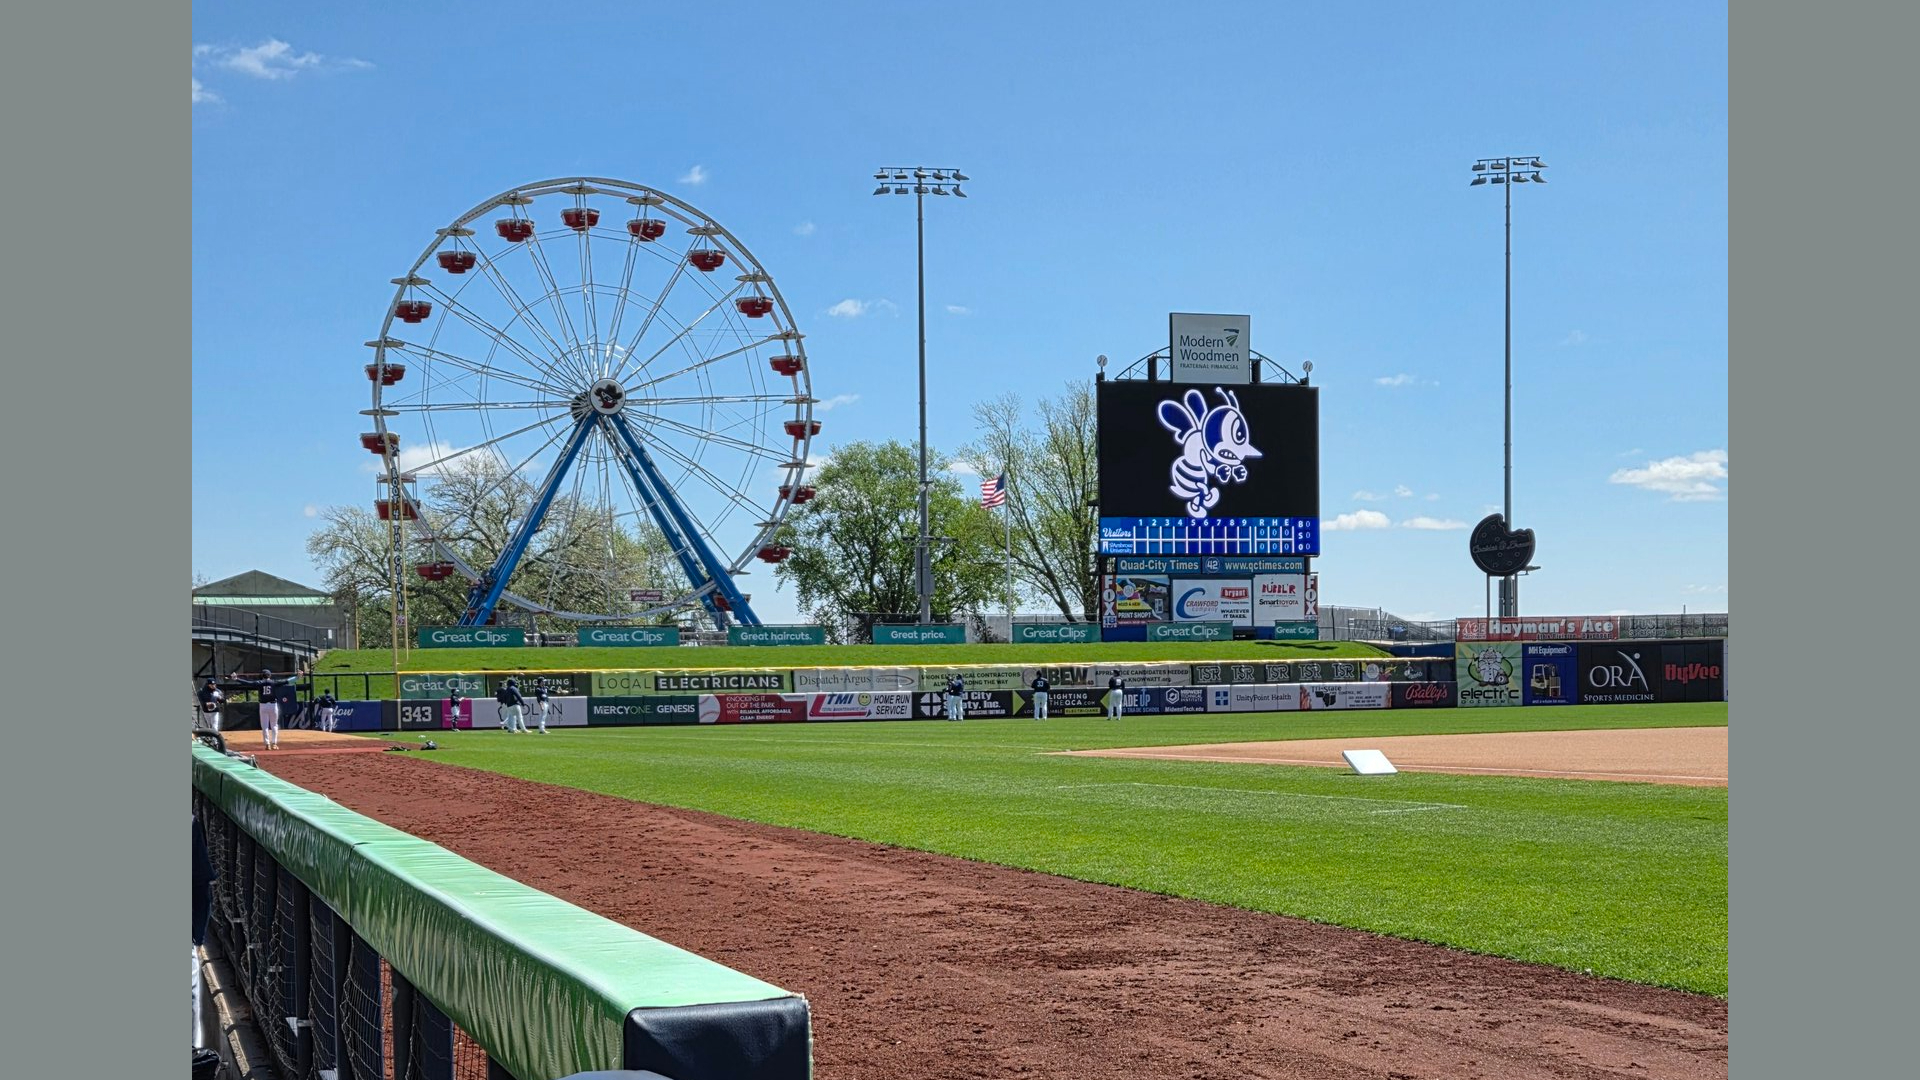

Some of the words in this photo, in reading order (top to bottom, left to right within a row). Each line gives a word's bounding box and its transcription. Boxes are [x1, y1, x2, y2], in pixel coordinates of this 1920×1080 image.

[1180, 335, 1223, 347] Modern
[1180, 349, 1239, 361] Woodmen
[1102, 528, 1132, 537] Visitors
[1120, 560, 1166, 572] Quad-City
[1170, 560, 1199, 569] Times
[1207, 561, 1218, 569] 42
[1225, 560, 1302, 572] www.qctimes.com
[1103, 575, 1115, 615] FOX
[1224, 589, 1245, 597] bryant
[1306, 576, 1316, 615] FOX
[1023, 628, 1057, 638] Great
[1058, 627, 1086, 640] Clips
[1157, 626, 1190, 637] Great
[1192, 625, 1219, 638] Clips
[1298, 627, 1315, 635] Clips
[1489, 619, 1575, 637] Hayman's
[1582, 619, 1614, 632] Ace
[432, 631, 472, 642] Great
[475, 630, 507, 645] Clips
[592, 630, 629, 642] Great
[631, 630, 662, 644] Clips
[740, 632, 768, 640] Great
[770, 632, 812, 640] haircuts.
[891, 631, 918, 639] Great
[921, 631, 946, 641] price.
[1539, 646, 1567, 655] Equipment
[1590, 658, 1648, 690] ORA
[403, 680, 444, 692] Great
[446, 678, 478, 693] Clips
[598, 678, 651, 689] LOCAL
[658, 676, 779, 689] ELECTRICIANS
[263, 686, 271, 695] 16
[971, 692, 992, 701] City
[1405, 684, 1447, 701] Bally's
[1461, 688, 1519, 699] electric
[827, 694, 854, 704] TMI
[874, 695, 893, 704] HOME
[897, 694, 910, 703] RUN
[402, 706, 432, 722] 343
[594, 705, 651, 715] MERCYONE
[657, 705, 695, 713] GENESIS
[876, 706, 907, 715] SERVICE!
